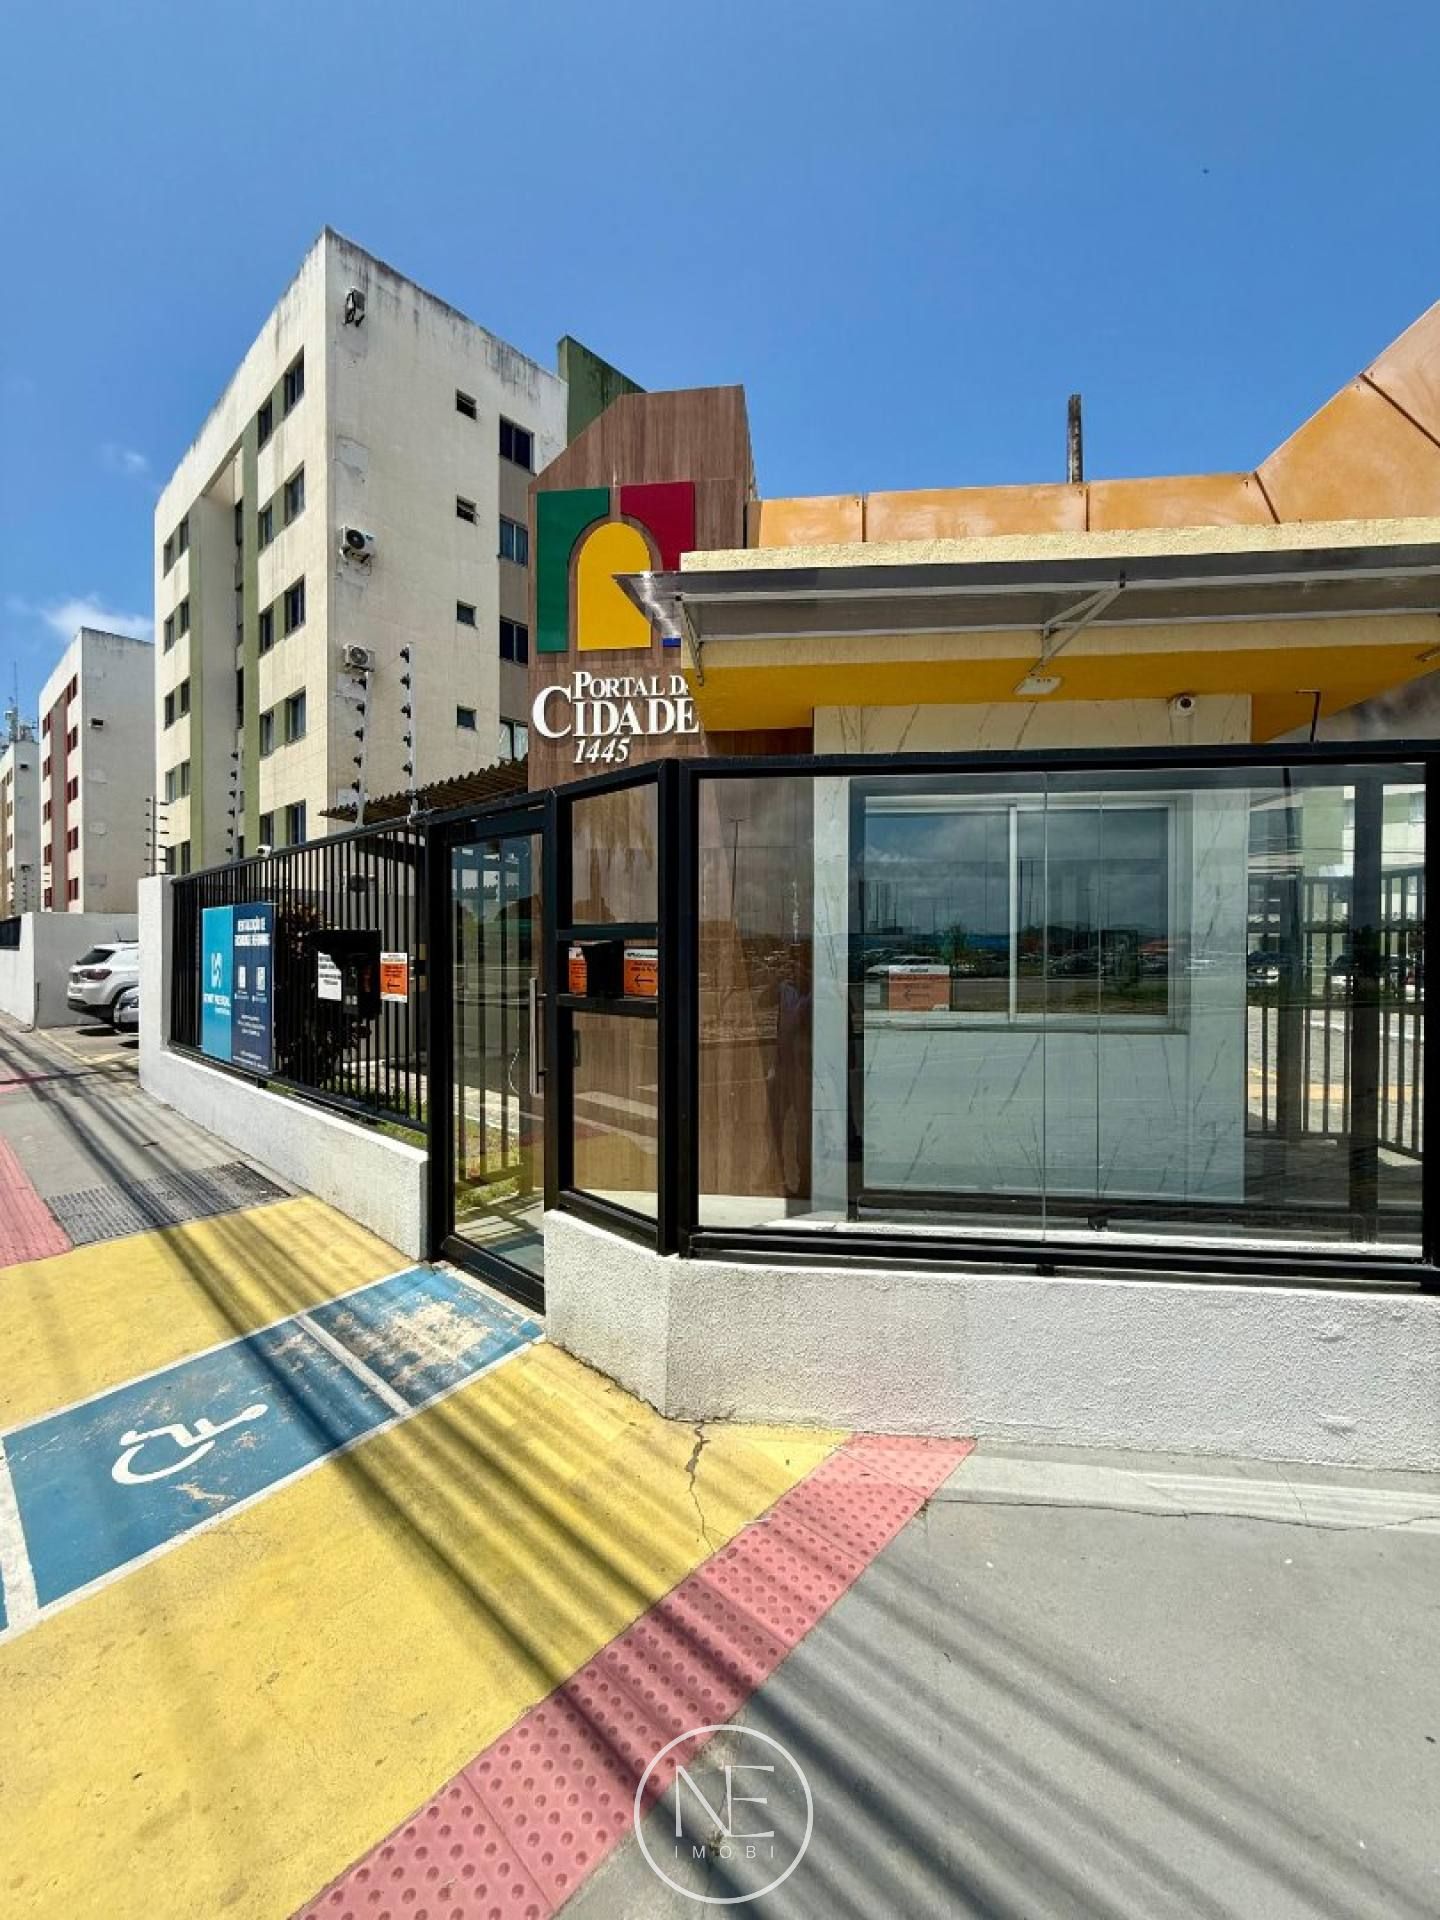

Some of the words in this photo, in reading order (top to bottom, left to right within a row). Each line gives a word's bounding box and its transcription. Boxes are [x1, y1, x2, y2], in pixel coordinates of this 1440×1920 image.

[572, 671, 666, 699] PORTAL
[669, 675, 689, 696] D
[532, 685, 700, 738] CIDADE
[573, 737, 632, 764] 1445
